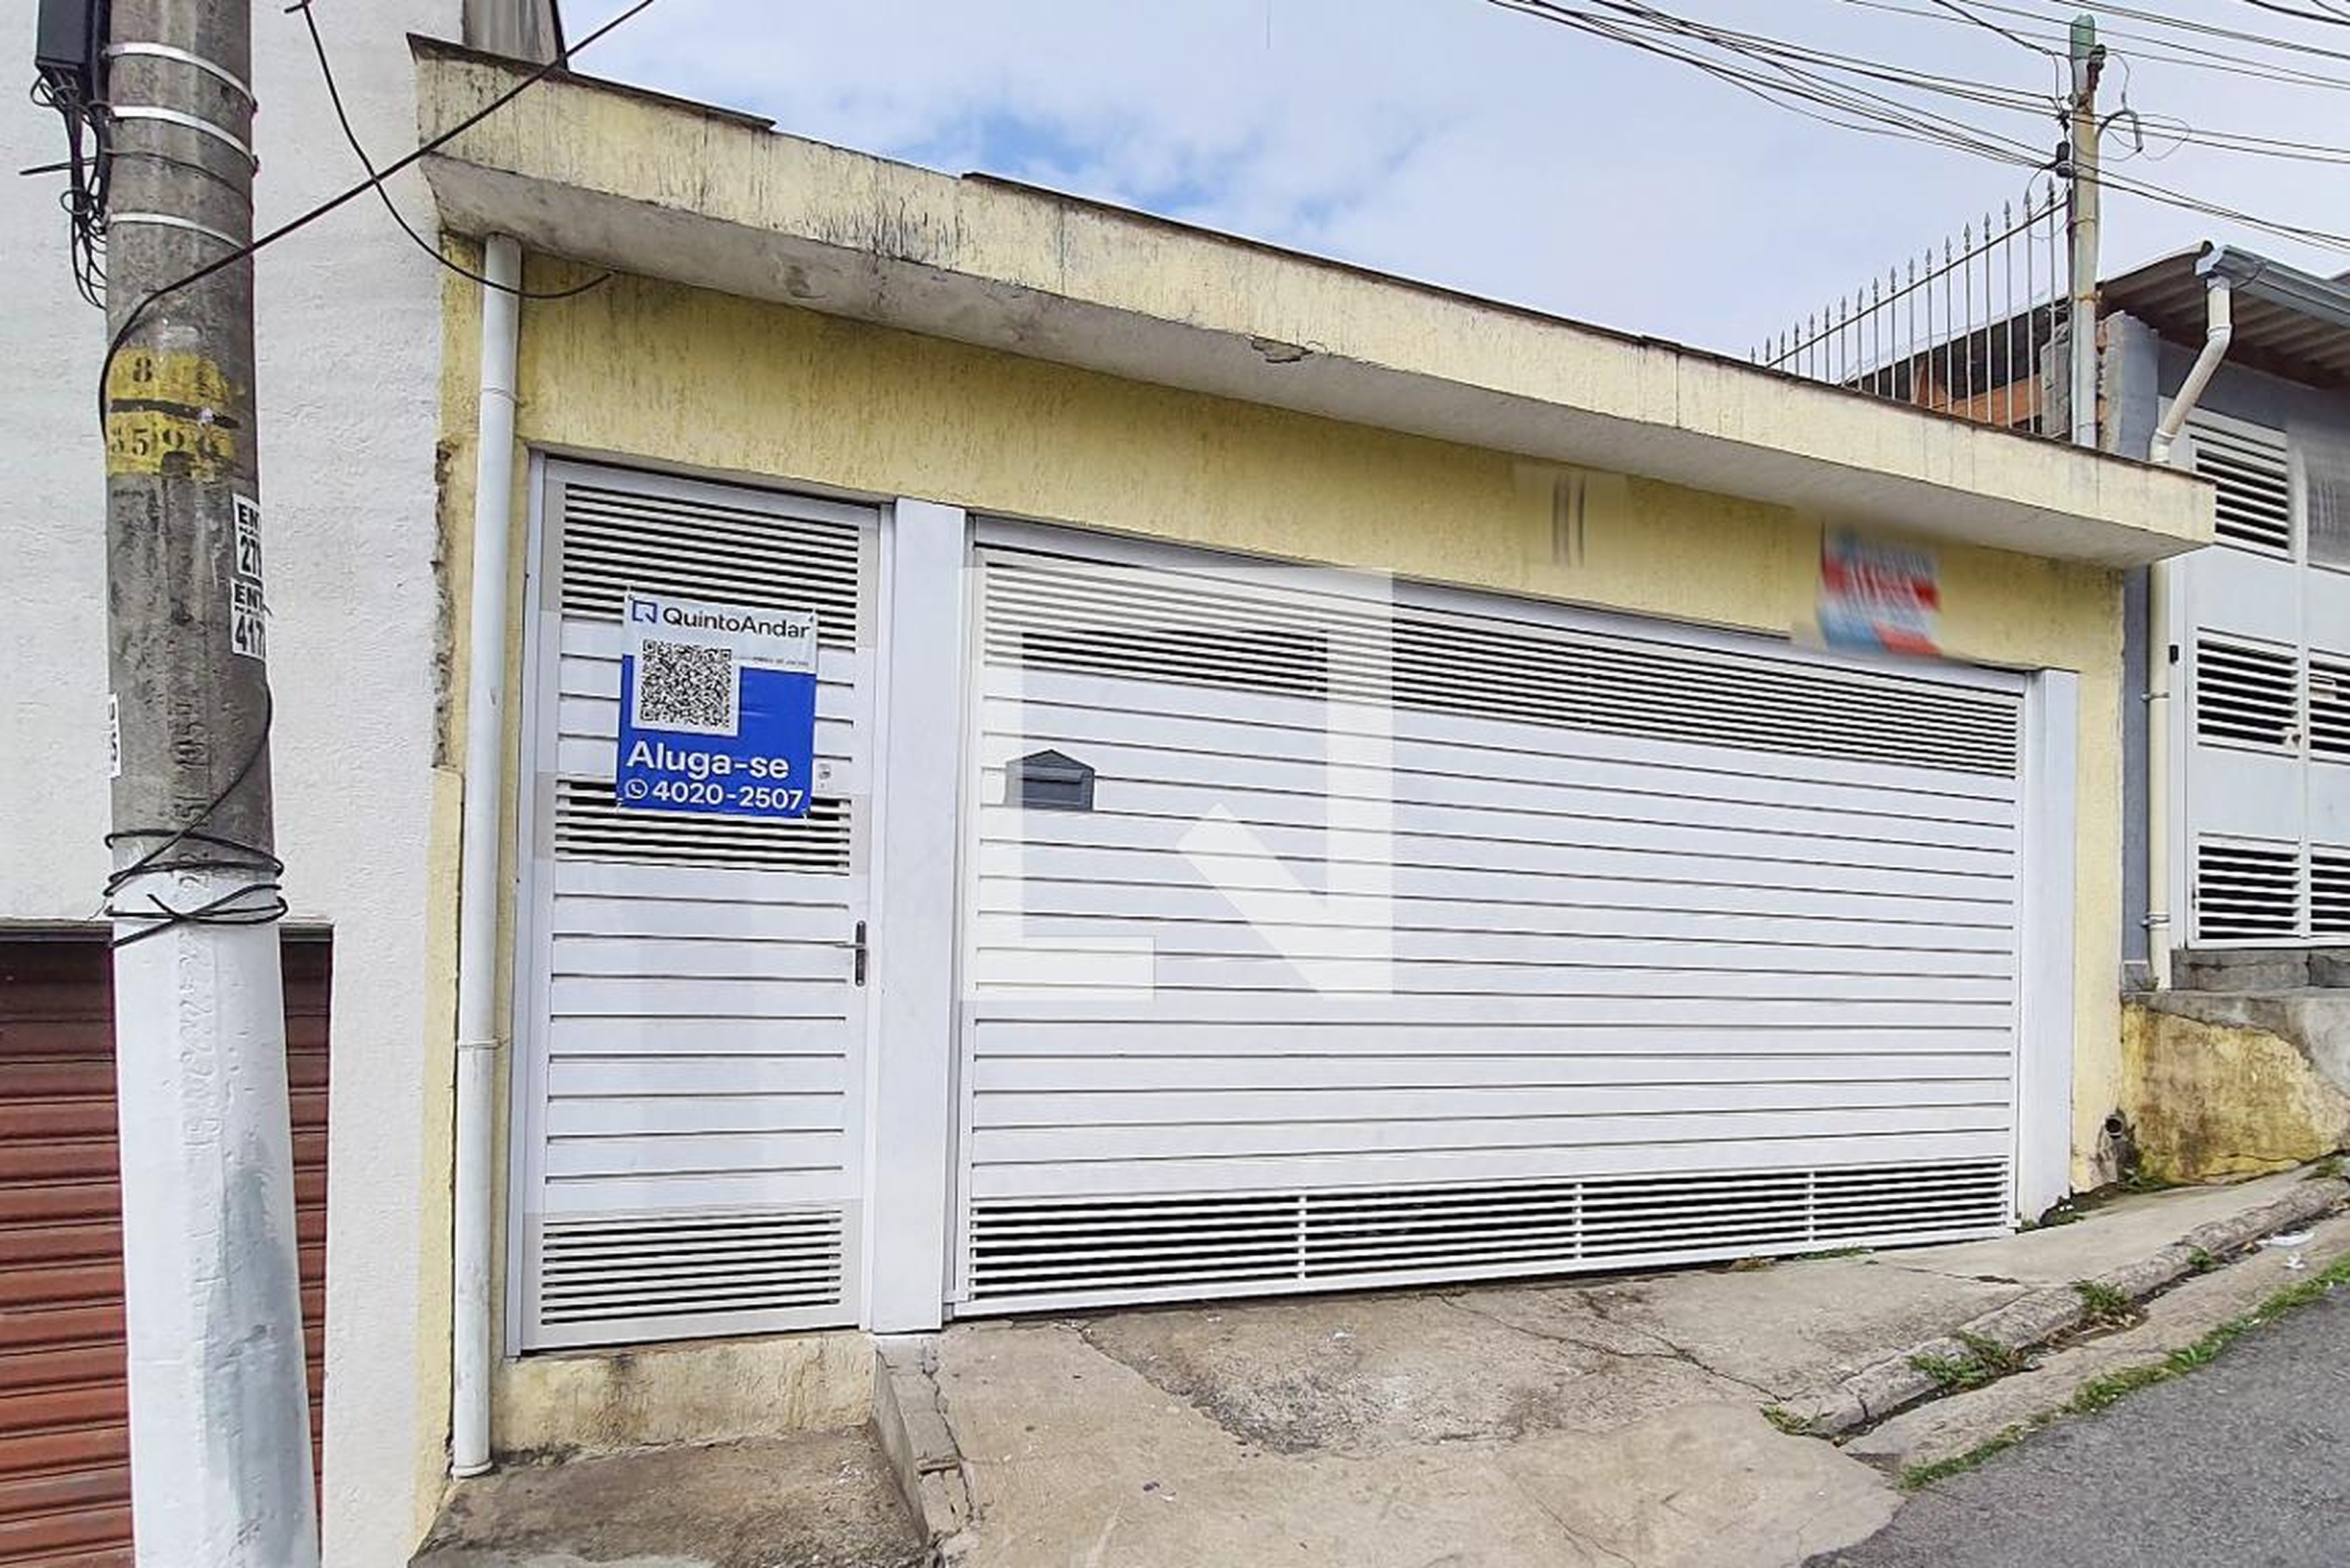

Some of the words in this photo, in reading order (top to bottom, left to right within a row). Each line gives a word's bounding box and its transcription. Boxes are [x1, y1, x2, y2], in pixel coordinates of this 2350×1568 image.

[663, 607, 810, 638] QuintoAndar
[627, 740, 789, 780] Aluga-se
[652, 780, 804, 810] 4020-2507
